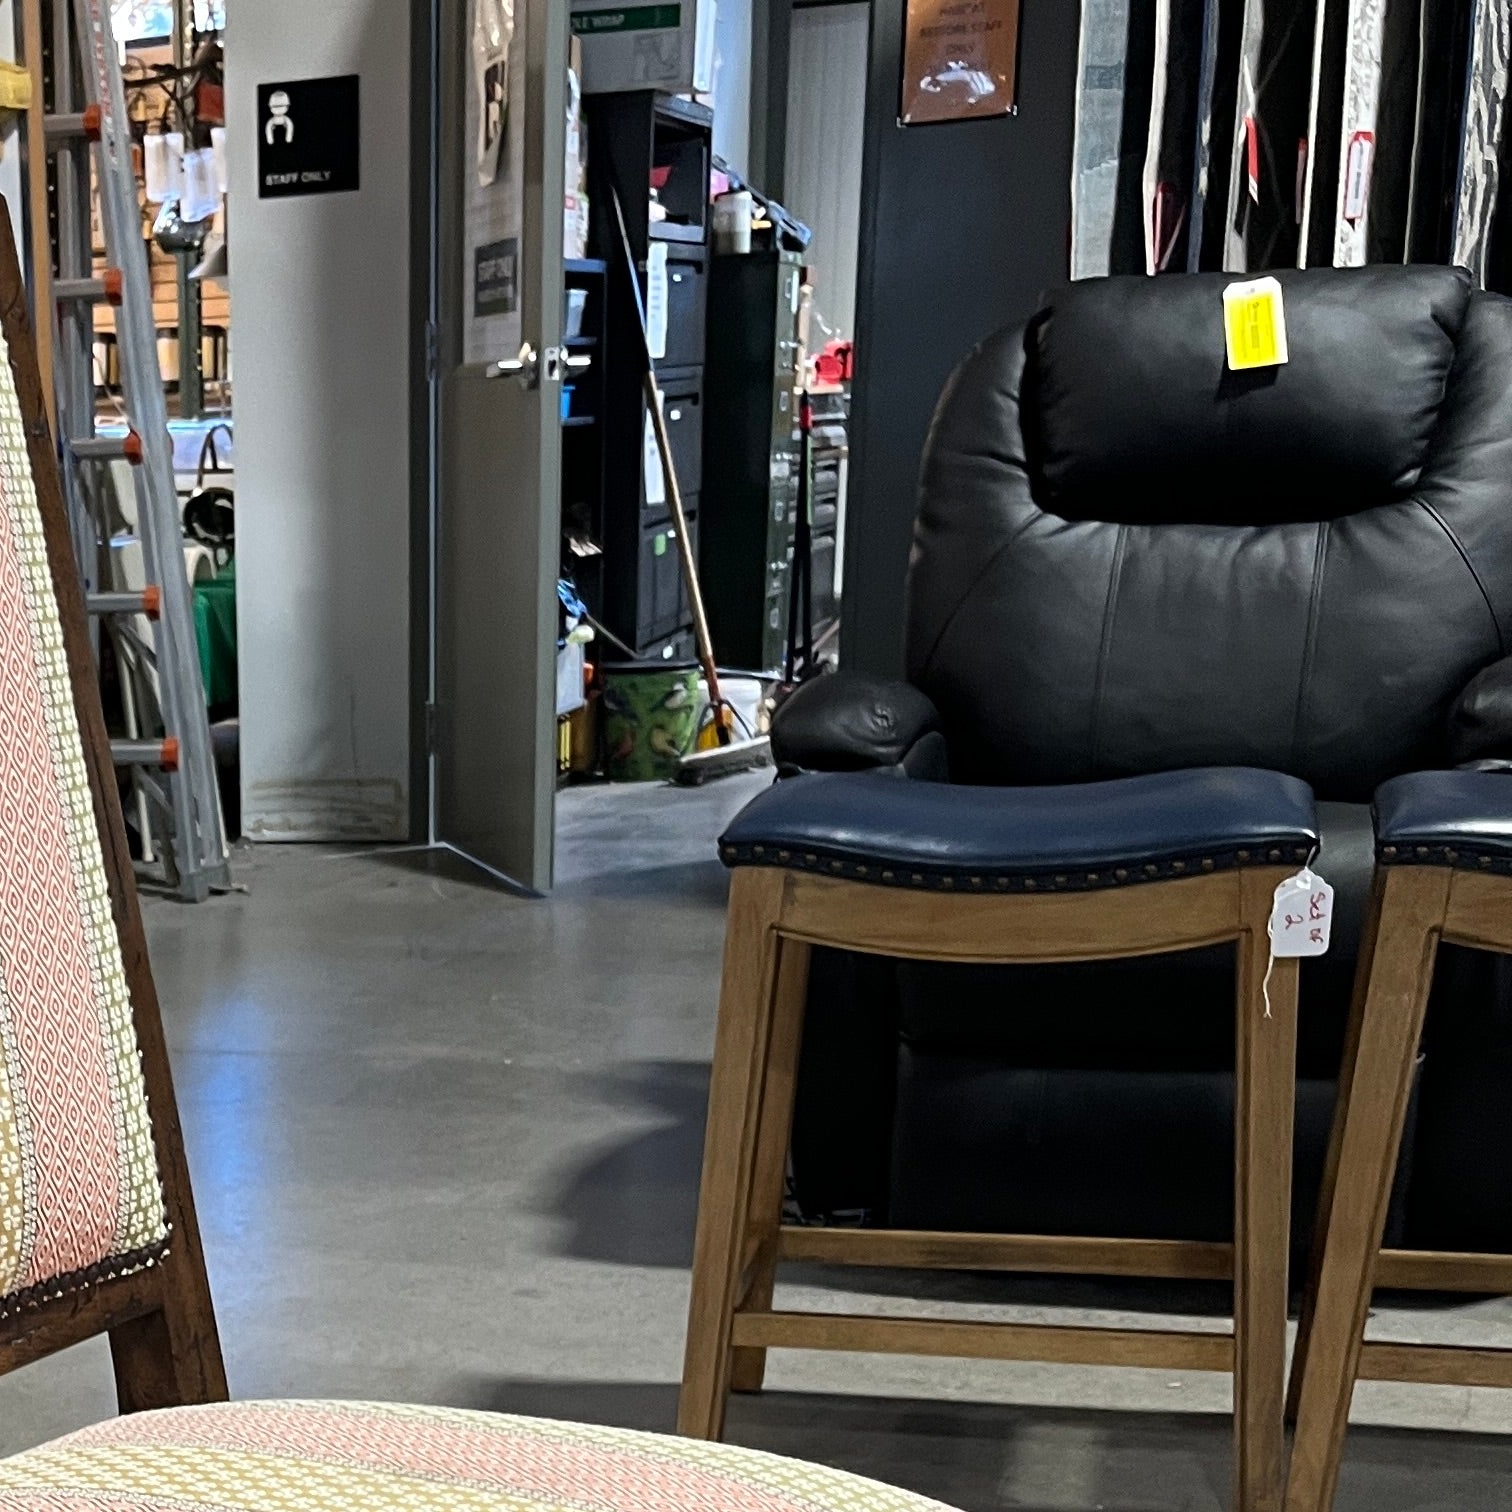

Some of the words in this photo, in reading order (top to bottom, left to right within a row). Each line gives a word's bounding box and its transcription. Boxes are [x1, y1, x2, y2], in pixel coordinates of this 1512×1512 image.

[265, 172, 299, 186] STAFF
[301, 170, 331, 183] ONLY
[1284, 913, 1305, 931] 2
